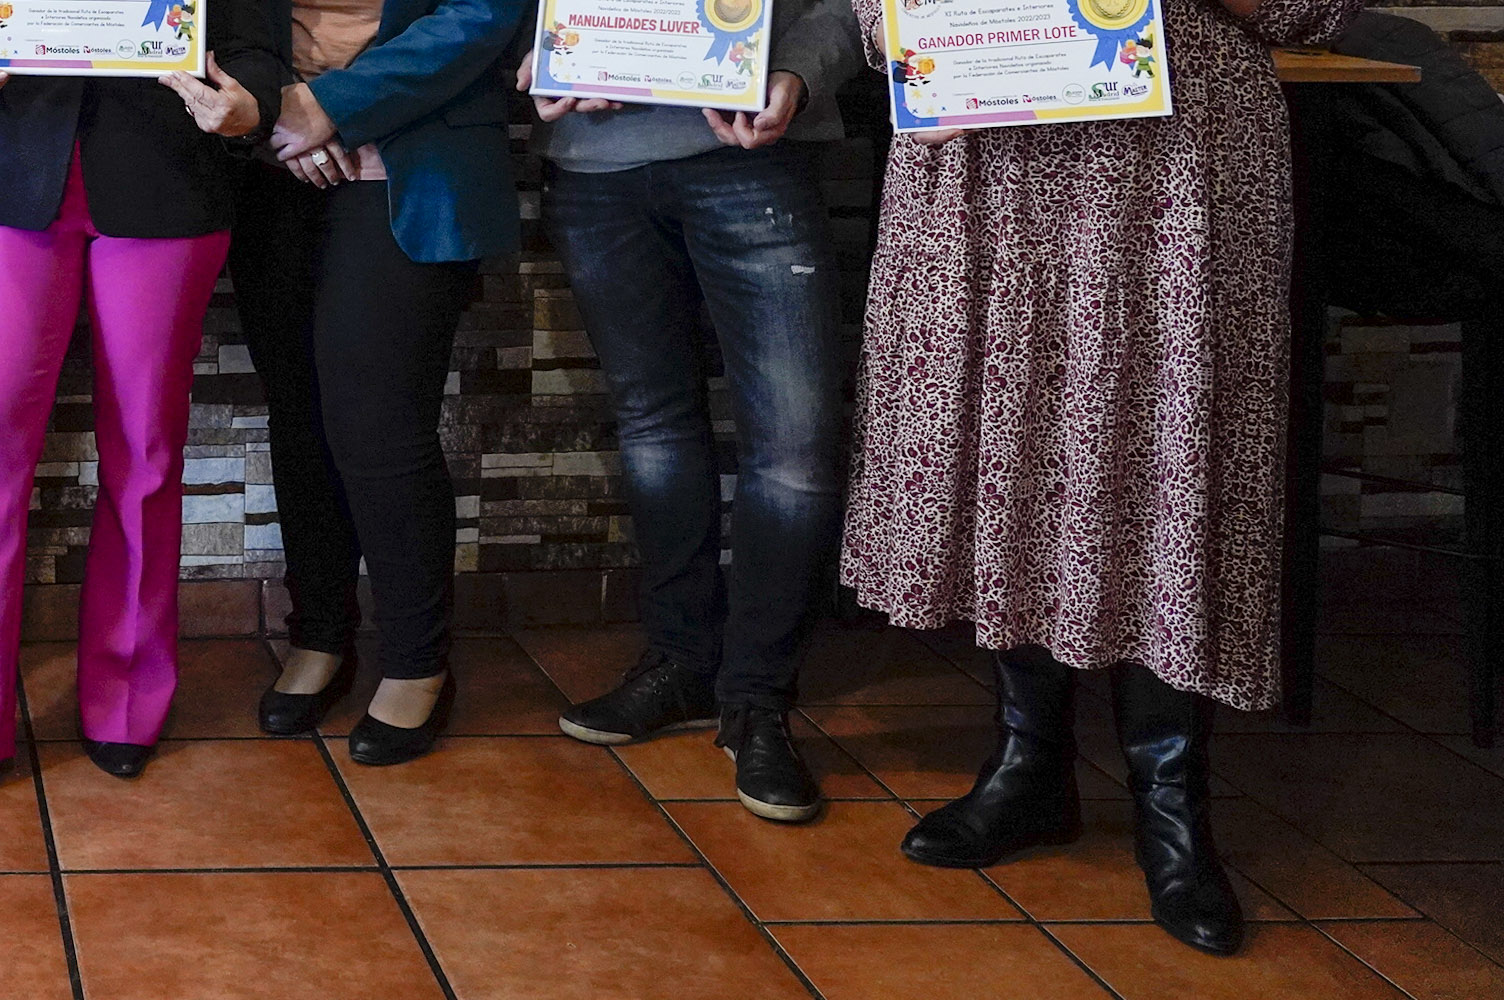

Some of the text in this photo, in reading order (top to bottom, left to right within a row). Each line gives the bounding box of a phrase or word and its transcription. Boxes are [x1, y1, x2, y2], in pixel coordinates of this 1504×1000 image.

[977, 5, 1015, 14] Escaparates
[568, 12, 700, 34] MANUALIDADES LUVER
[988, 16, 1015, 24] Móstoles
[917, 25, 1077, 49] GANADOR PRIMER LOTE
[46, 45, 79, 53] Móstoles
[607, 72, 640, 82] Móstoles
[978, 96, 1018, 106] Móstoles
